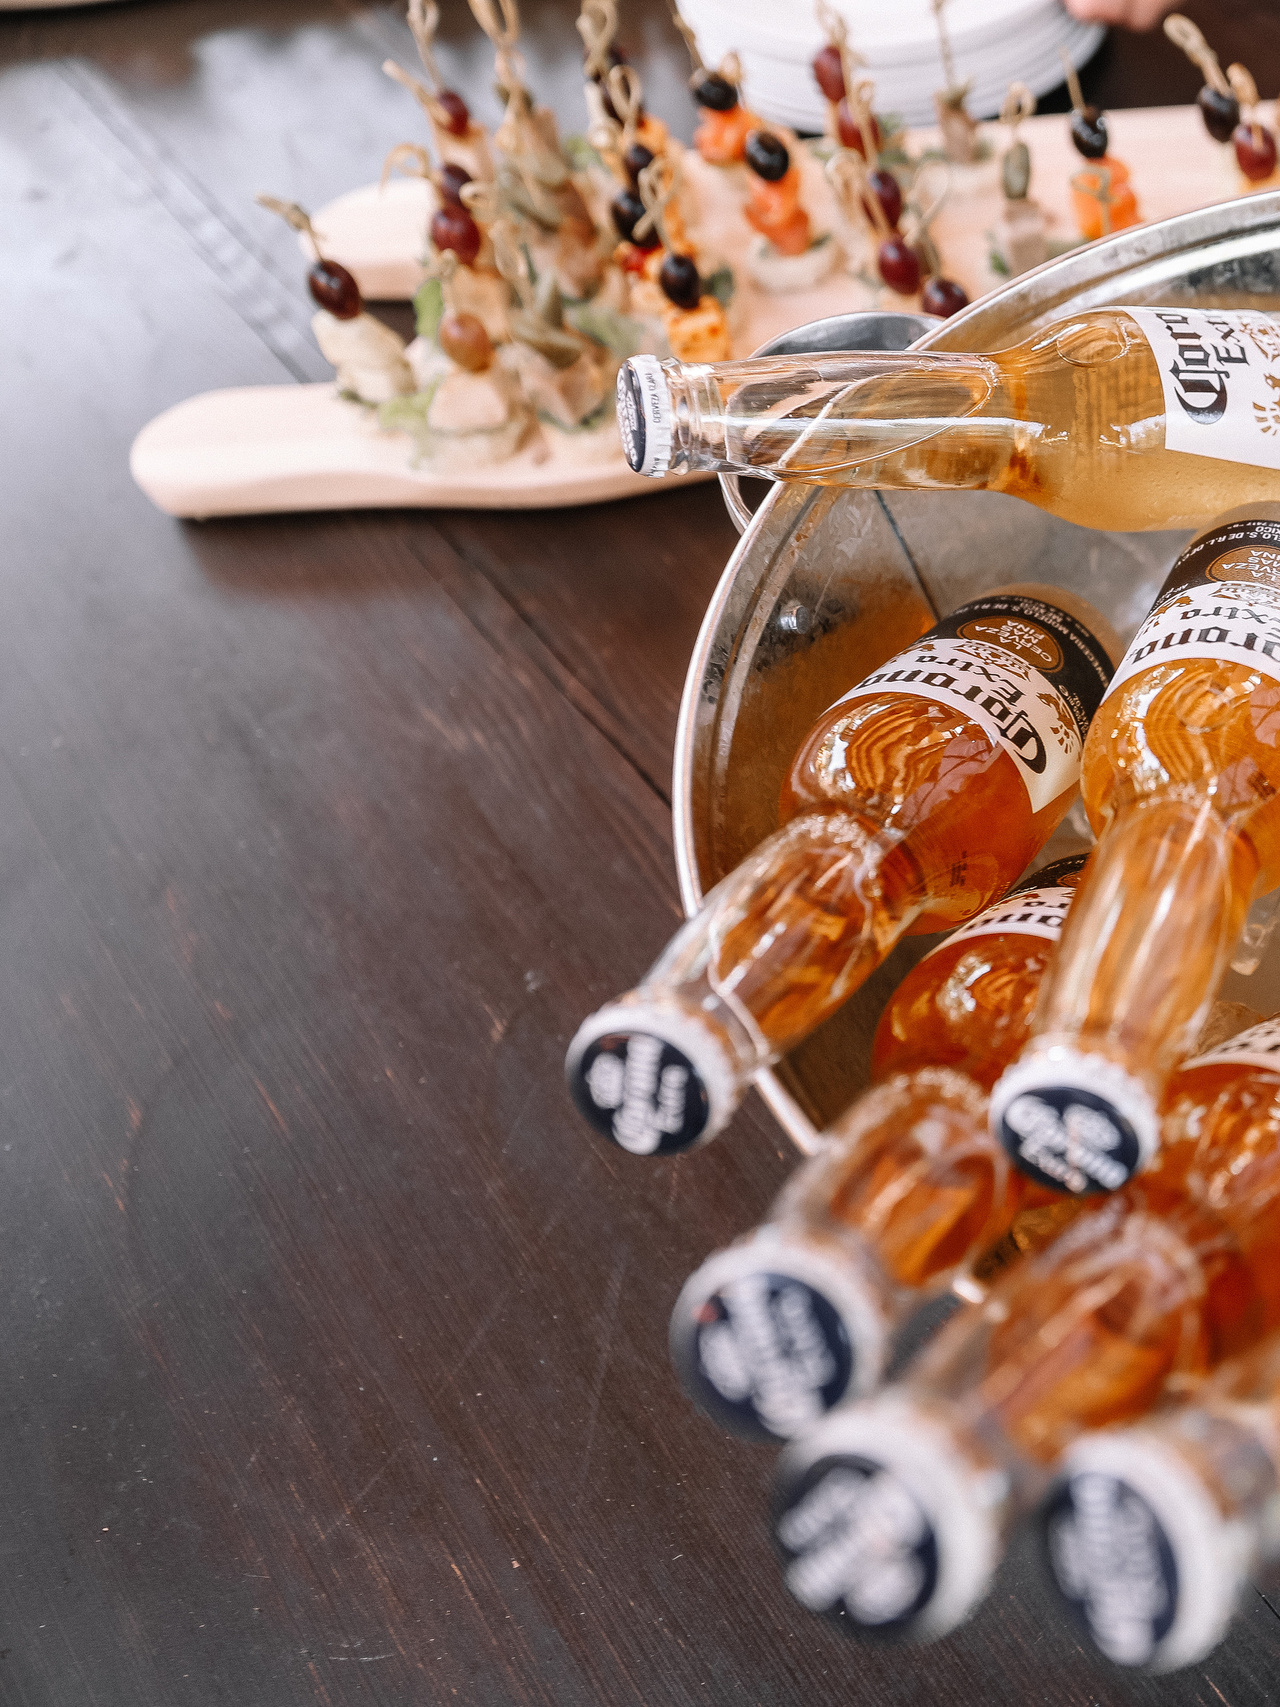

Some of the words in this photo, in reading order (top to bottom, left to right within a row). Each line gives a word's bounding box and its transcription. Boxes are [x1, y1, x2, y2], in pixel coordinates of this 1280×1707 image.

[1228, 532, 1244, 541] DE
[1250, 570, 1276, 582] LA
[999, 624, 1039, 644] MAS
[1006, 619, 1045, 639] FINA
[974, 625, 1052, 662] CERVEZA
[999, 636, 1022, 650] LA
[915, 655, 1026, 708] Extra
[854, 669, 1047, 775] Corona
